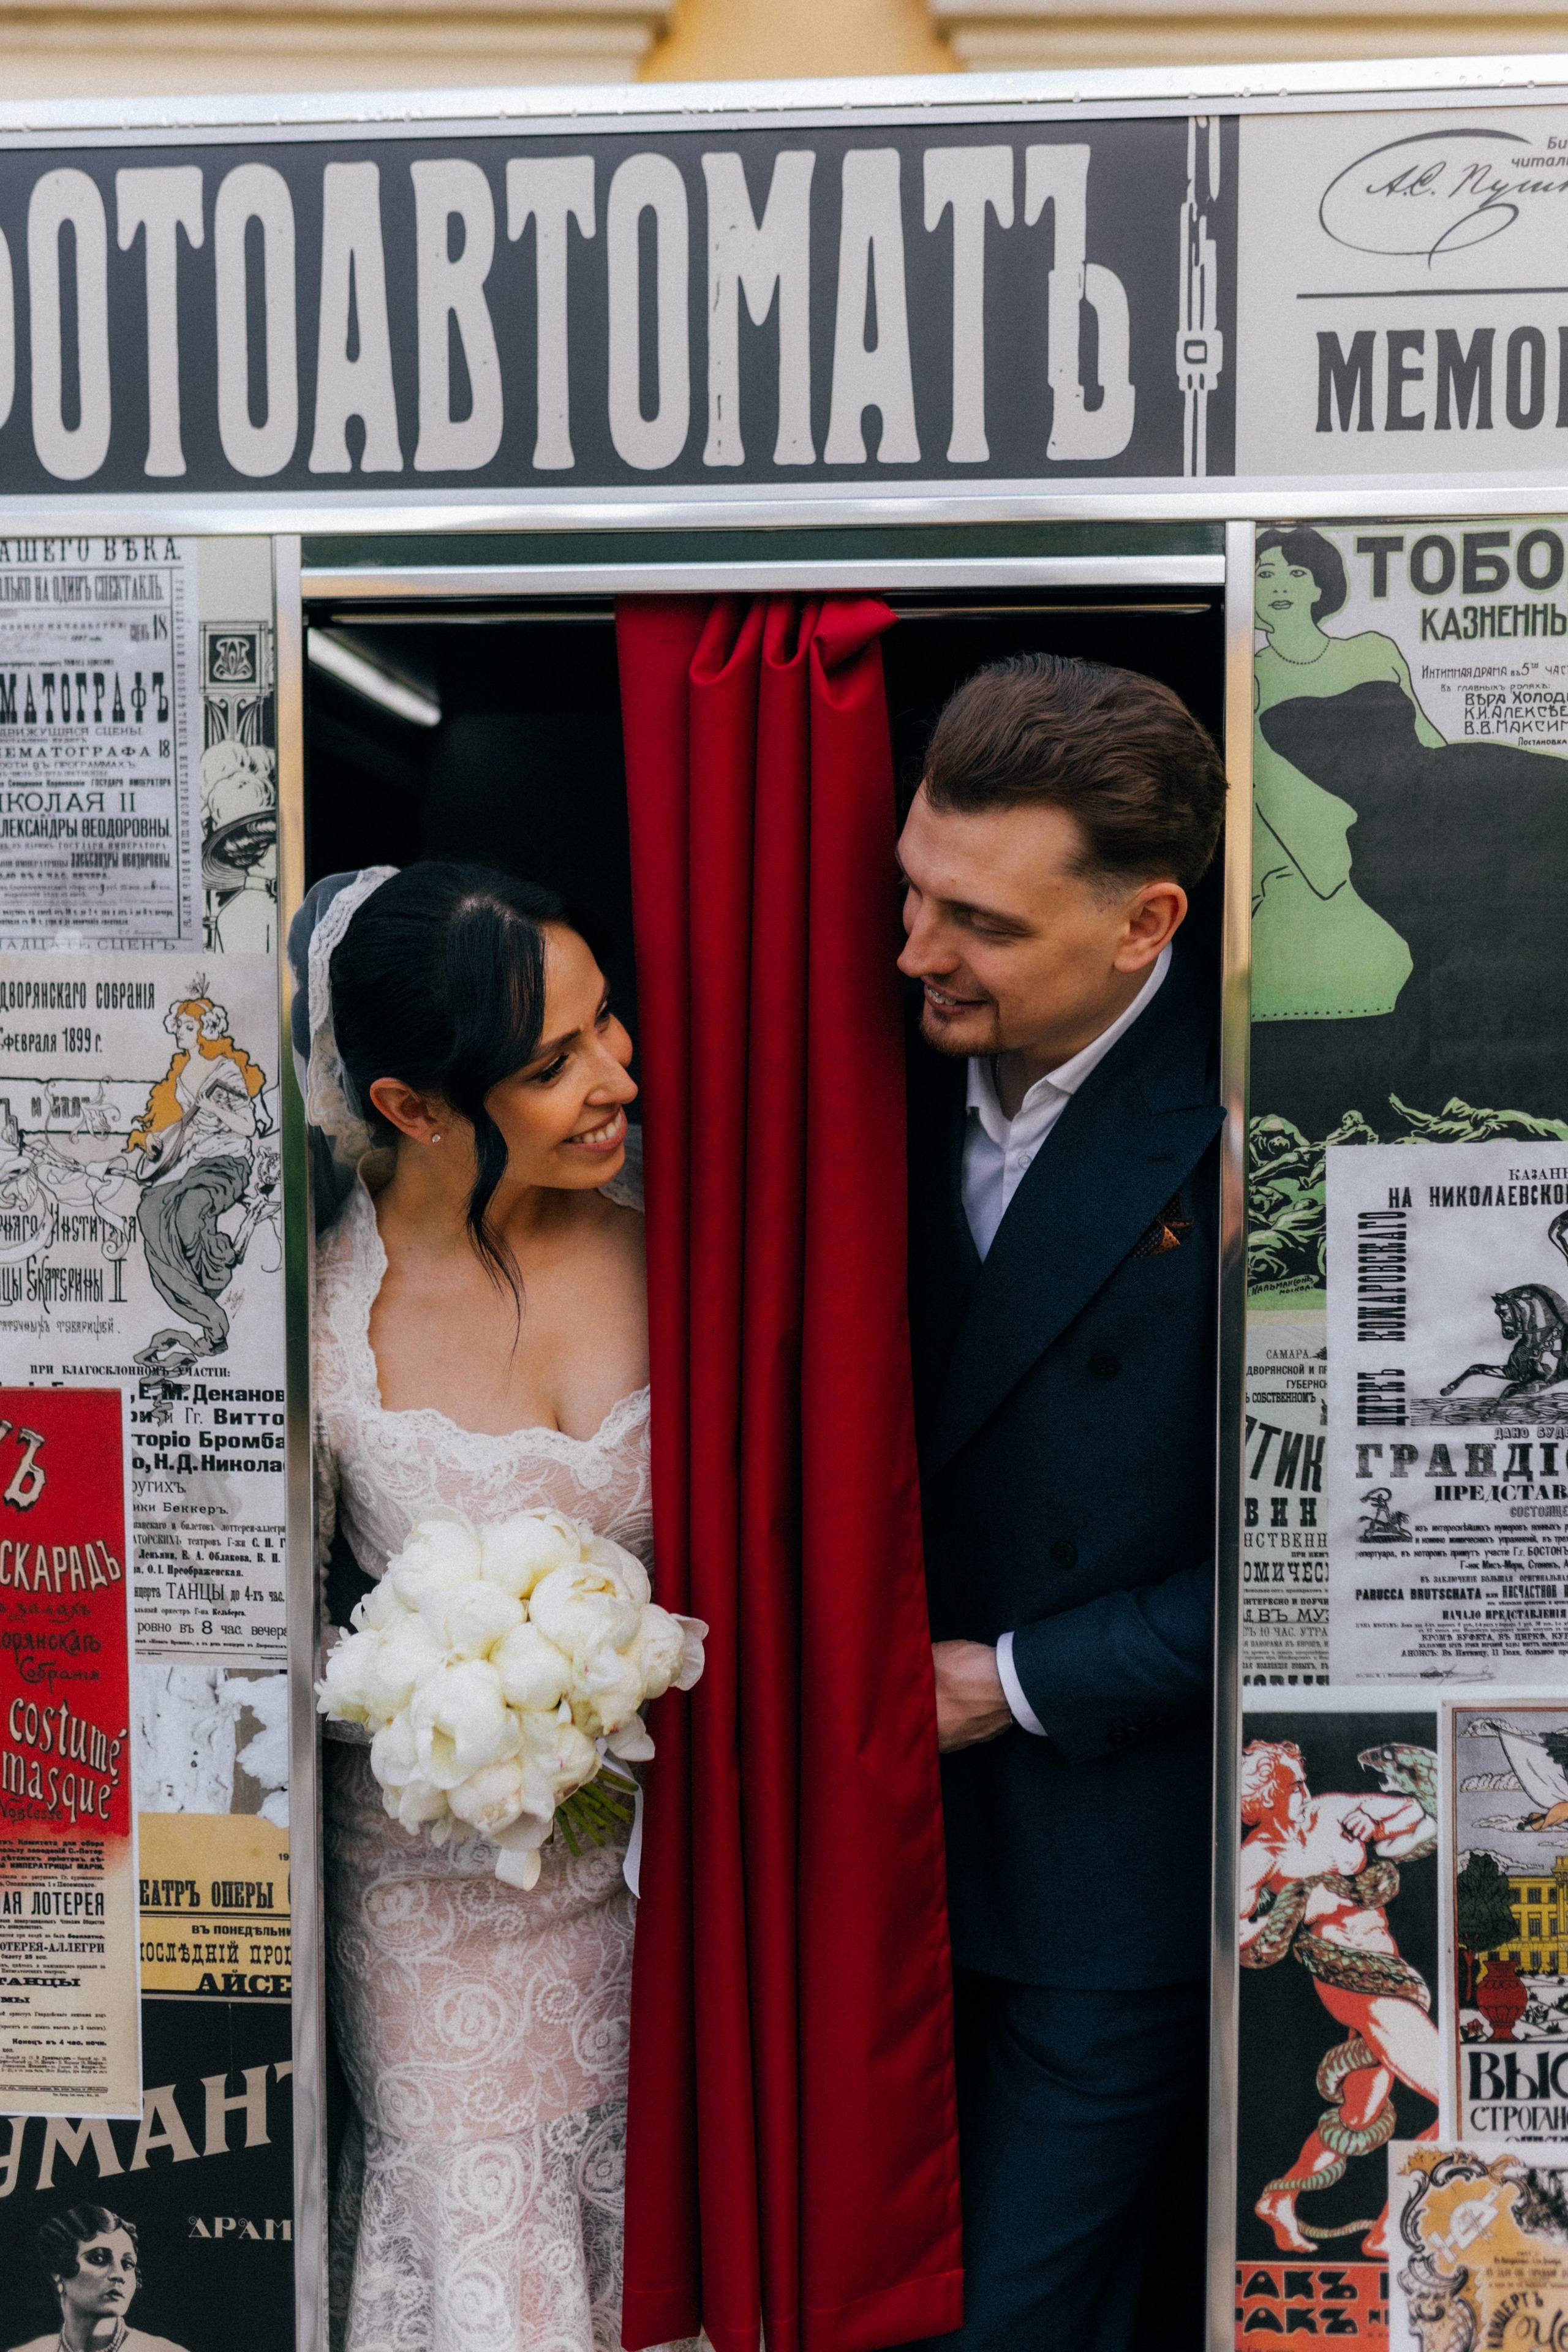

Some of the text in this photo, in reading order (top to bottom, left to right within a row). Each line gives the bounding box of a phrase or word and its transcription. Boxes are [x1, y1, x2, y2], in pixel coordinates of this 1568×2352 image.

[1511, 156, 1568, 168] читал
[0, 143, 1136, 481] ОТОАВТОМАТЪ
[1356, 529, 1564, 598] ТОБО
[35, 576, 49, 602] НА
[153, 614, 168, 641] 18
[1512, 692, 1568, 704] ХОЛОД
[0, 739, 170, 758] ЕМАТОГРАФА 18
[62, 1027, 91, 1053] 1899
[1389, 1184, 1568, 1208] НА НИКОЛАЕВСКО
[31, 1364, 54, 1374] ПРИ
[1246, 1365, 1314, 1376] ДВОРЯНСКОЙ И
[1494, 1427, 1529, 1440] ДАНО
[202, 1454, 285, 1472] Никола
[1355, 1442, 1568, 1482] ГРАНДІ
[163, 1502, 228, 1515] Беккеръ.
[188, 1538, 221, 1548] театровъ
[1243, 1562, 1329, 1583] ОМИЧЕС
[166, 1582, 224, 1604] ТАНЦЫ
[1259, 1608, 1287, 1622] ВЪ
[137, 1623, 172, 1635] ровно
[179, 1624, 194, 1634] въ
[202, 1620, 213, 1634] 8
[3, 1891, 104, 1916] АЯ ЛОТЕРЕЯ
[139, 1879, 274, 1909] ЕАТРЪ ОПЕРЫ
[192, 1925, 209, 1934] ВЪ
[1471, 2106, 1568, 2132] СТРОГАН
